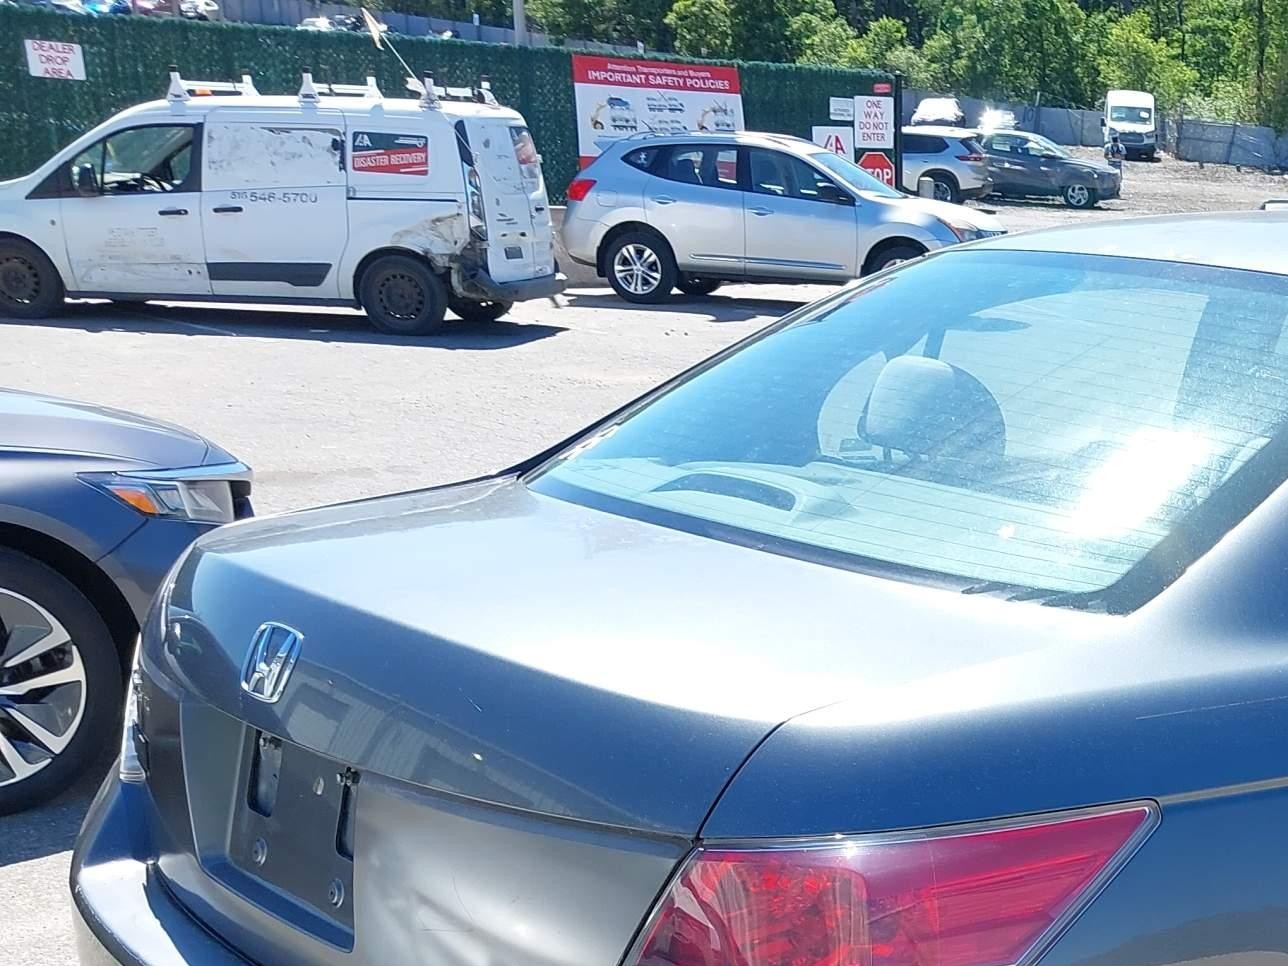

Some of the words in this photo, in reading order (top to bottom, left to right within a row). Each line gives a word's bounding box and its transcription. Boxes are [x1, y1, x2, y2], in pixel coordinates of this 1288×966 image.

[32, 41, 75, 54] DEALER
[39, 54, 69, 66] DROP
[44, 67, 74, 78] AREA
[588, 70, 645, 84] IMPORTANT
[649, 75, 684, 87] SAFETY
[687, 78, 730, 90] POLICIES
[865, 100, 882, 109] ONE
[863, 111, 885, 119] WAY
[859, 121, 871, 130] DO
[872, 122, 888, 130] NOT
[862, 132, 886, 141] ENTER
[353, 155, 389, 168] DISASTER
[390, 152, 426, 165] RECOVERY
[864, 168, 892, 185] OP
